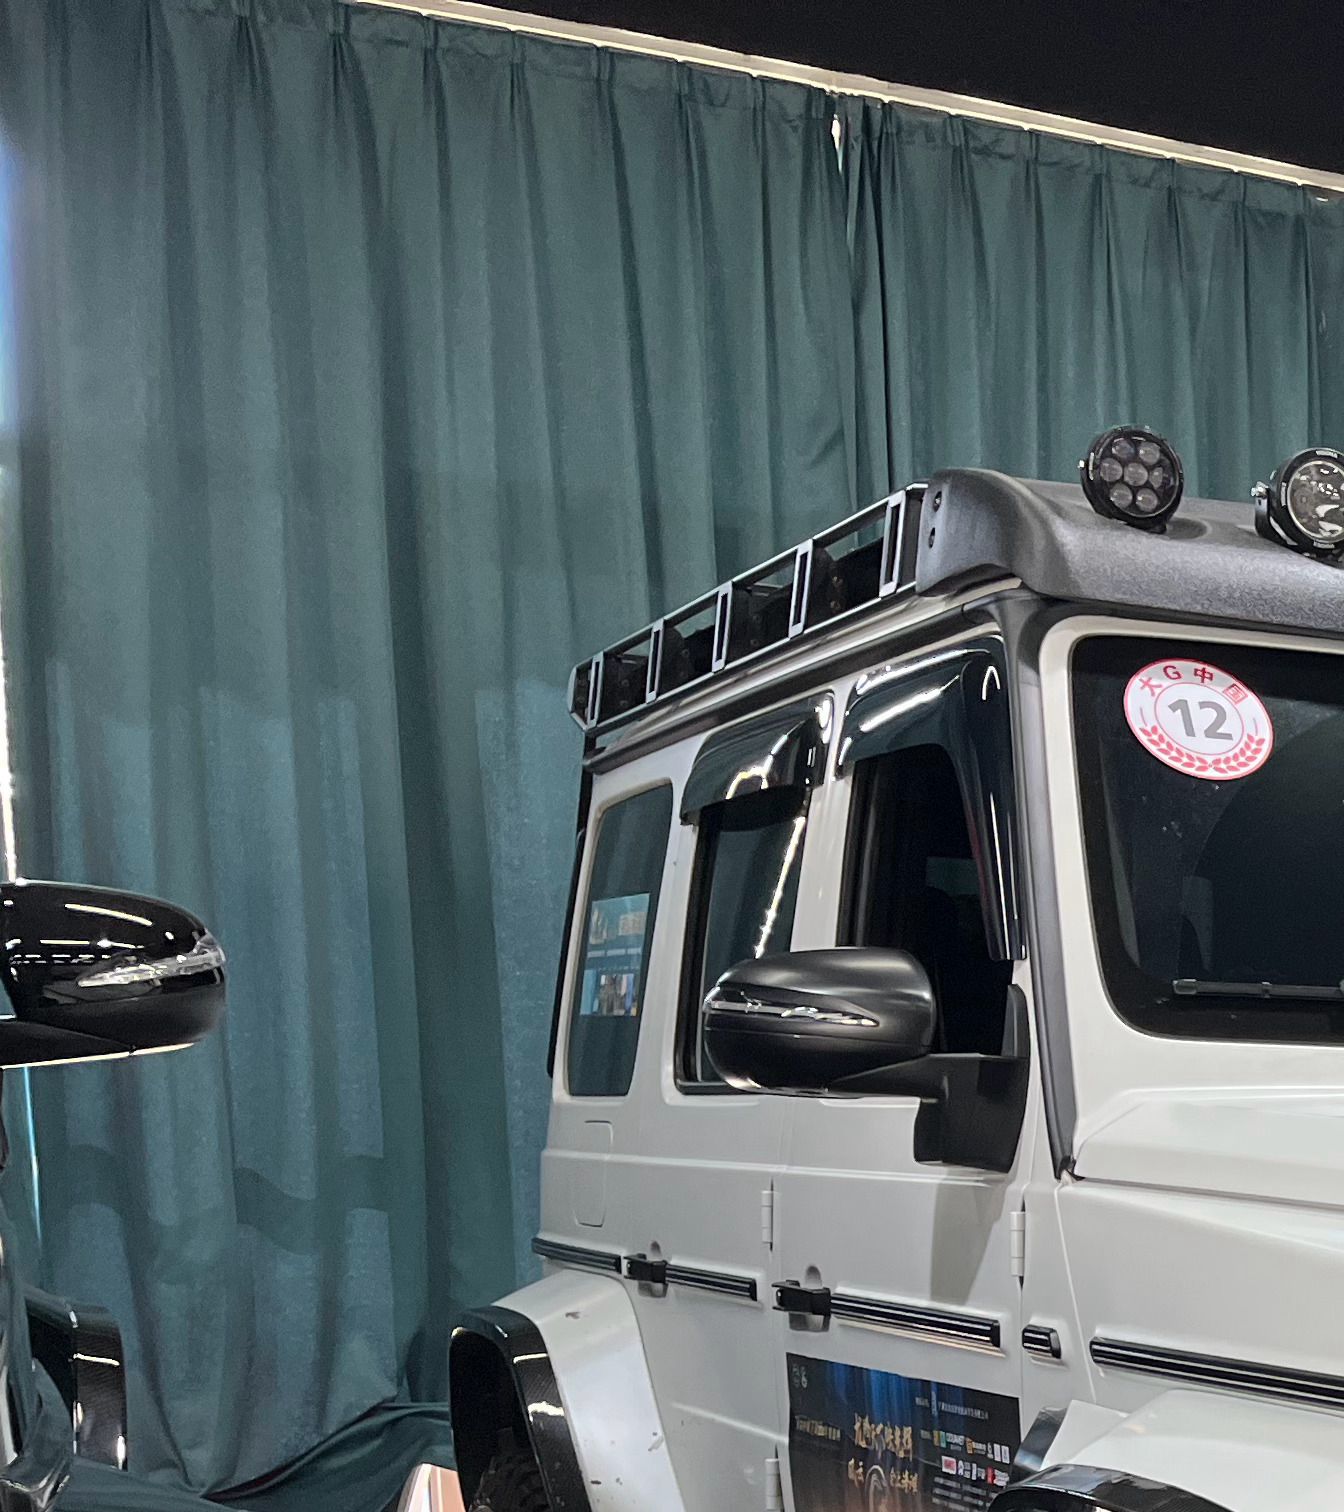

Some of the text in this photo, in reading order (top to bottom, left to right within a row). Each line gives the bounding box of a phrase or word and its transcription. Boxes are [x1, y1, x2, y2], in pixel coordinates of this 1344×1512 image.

[1139, 665, 1248, 705] 大G中国
[1168, 698, 1234, 741] 12
